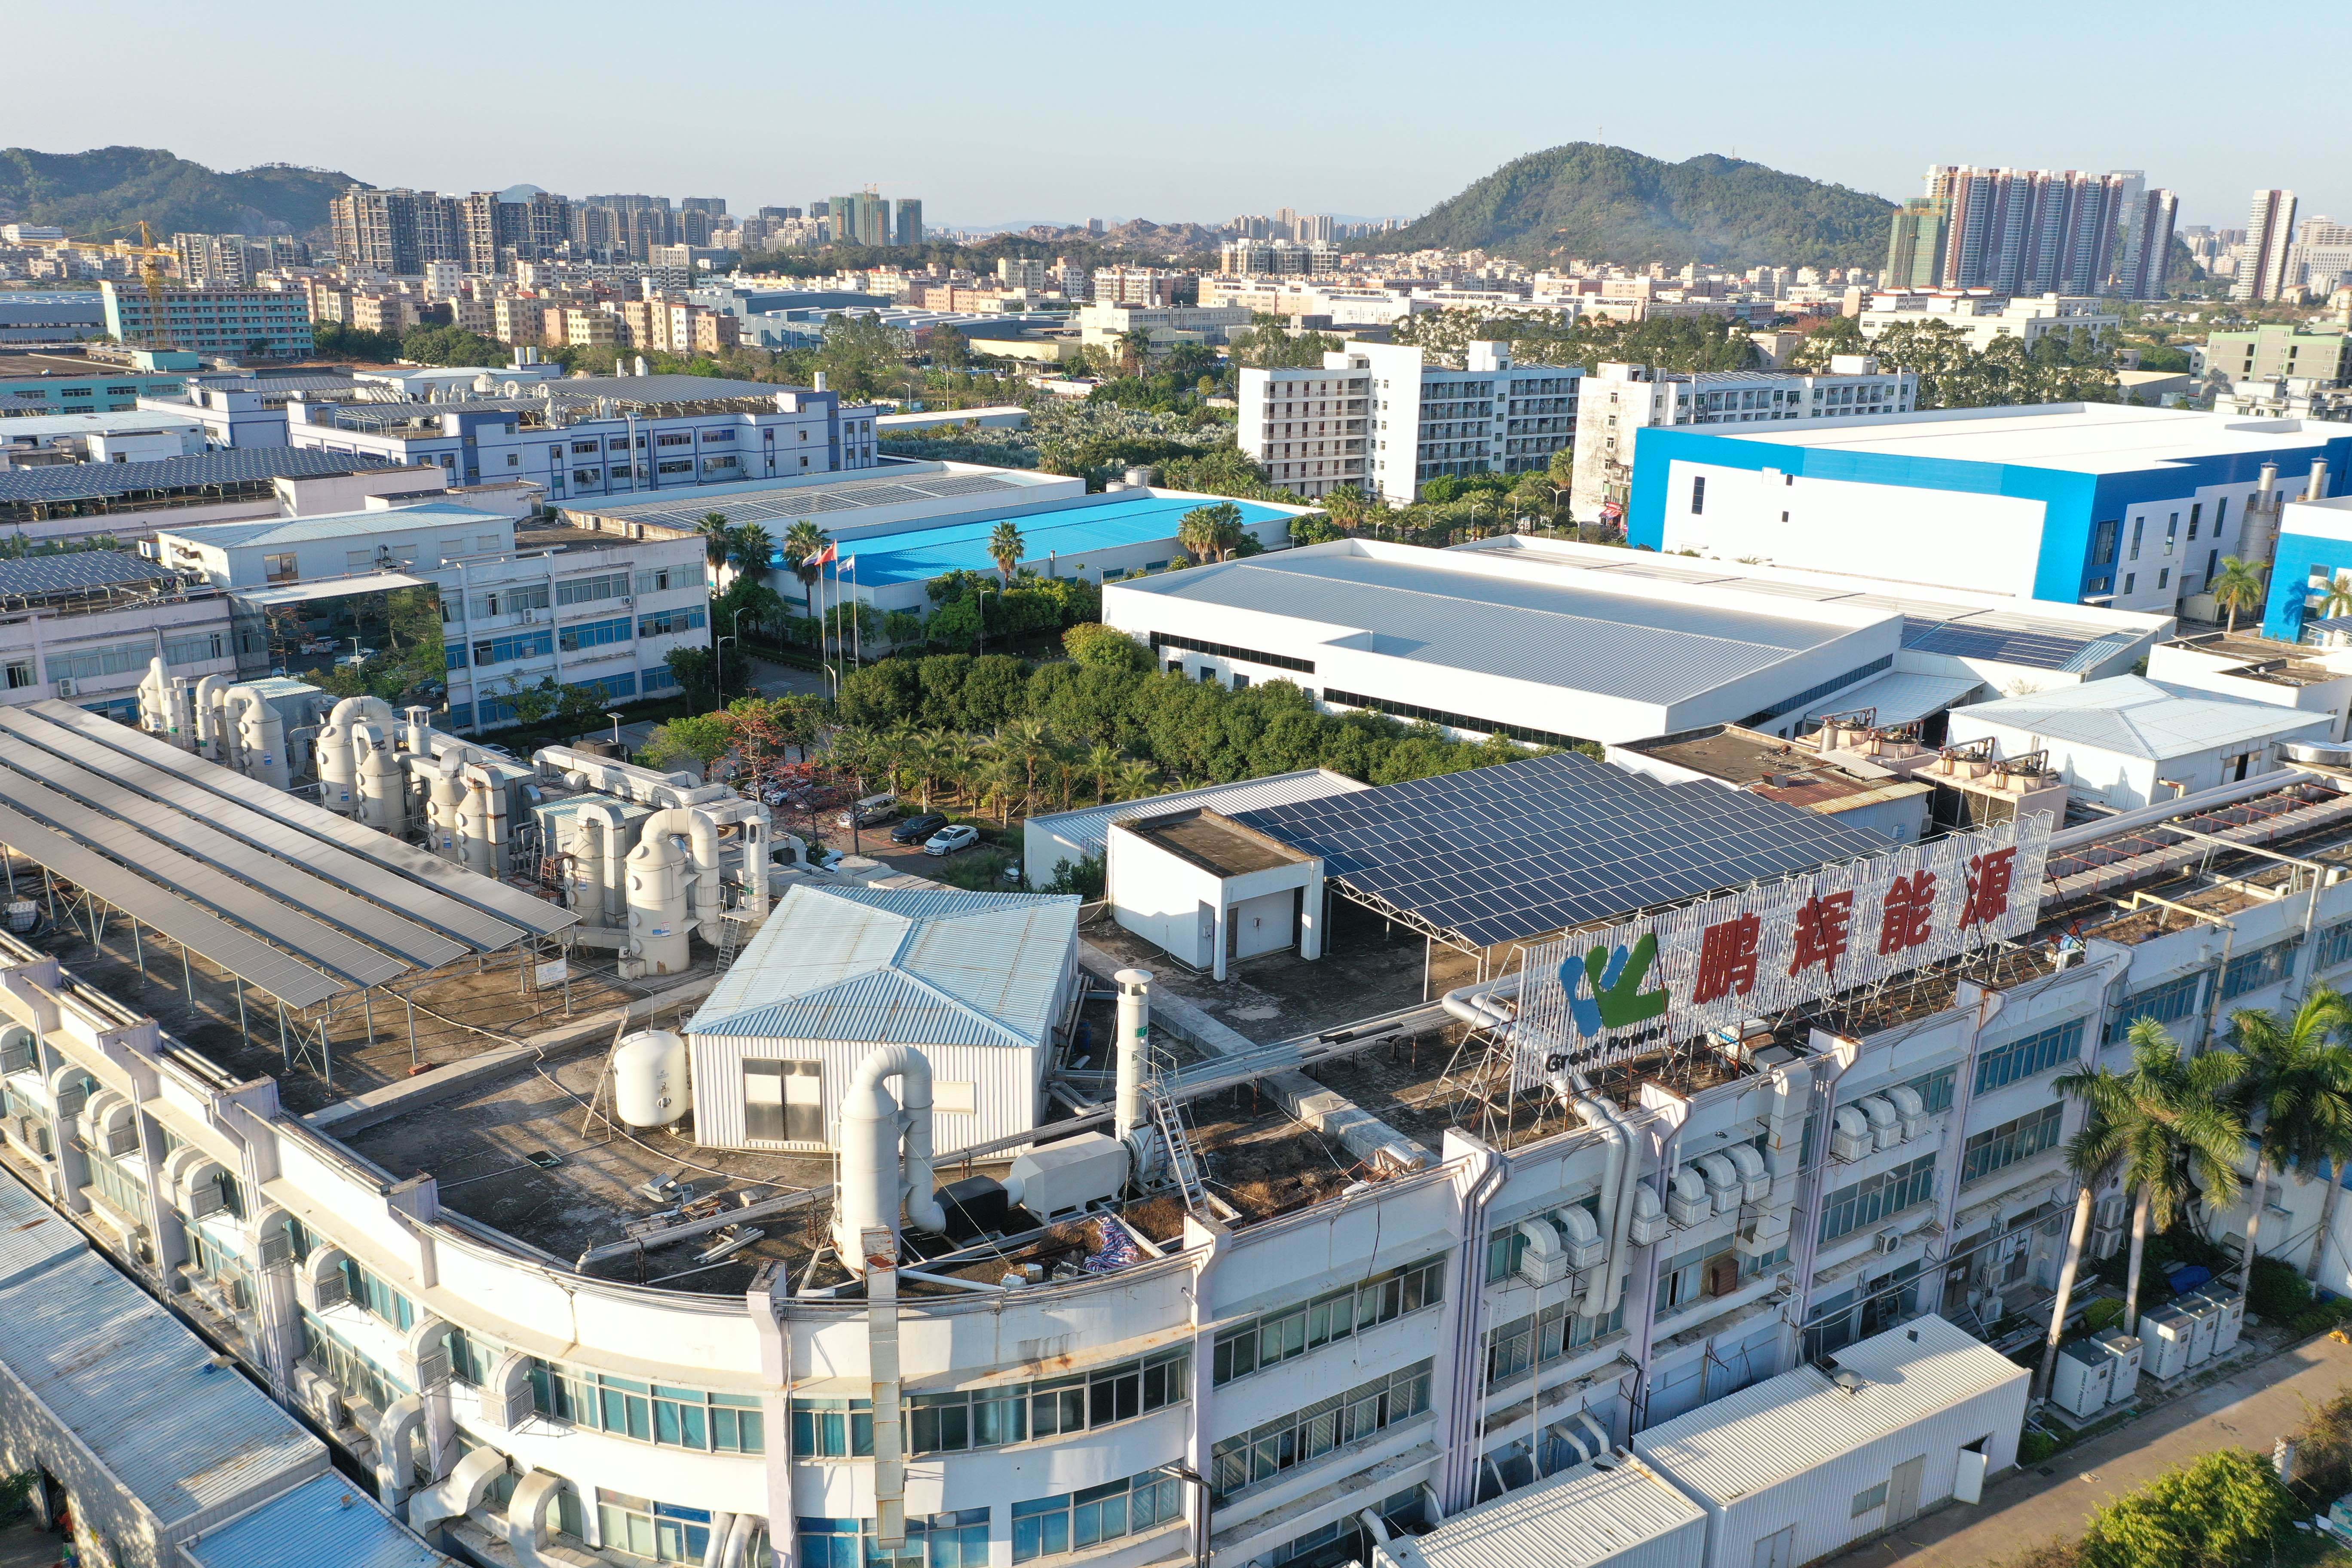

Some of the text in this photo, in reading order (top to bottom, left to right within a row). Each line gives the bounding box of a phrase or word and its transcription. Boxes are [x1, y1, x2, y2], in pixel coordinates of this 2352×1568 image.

[1693, 846, 2017, 1004] 鹏辉能源
[1545, 1024, 1667, 1072] Great Power
